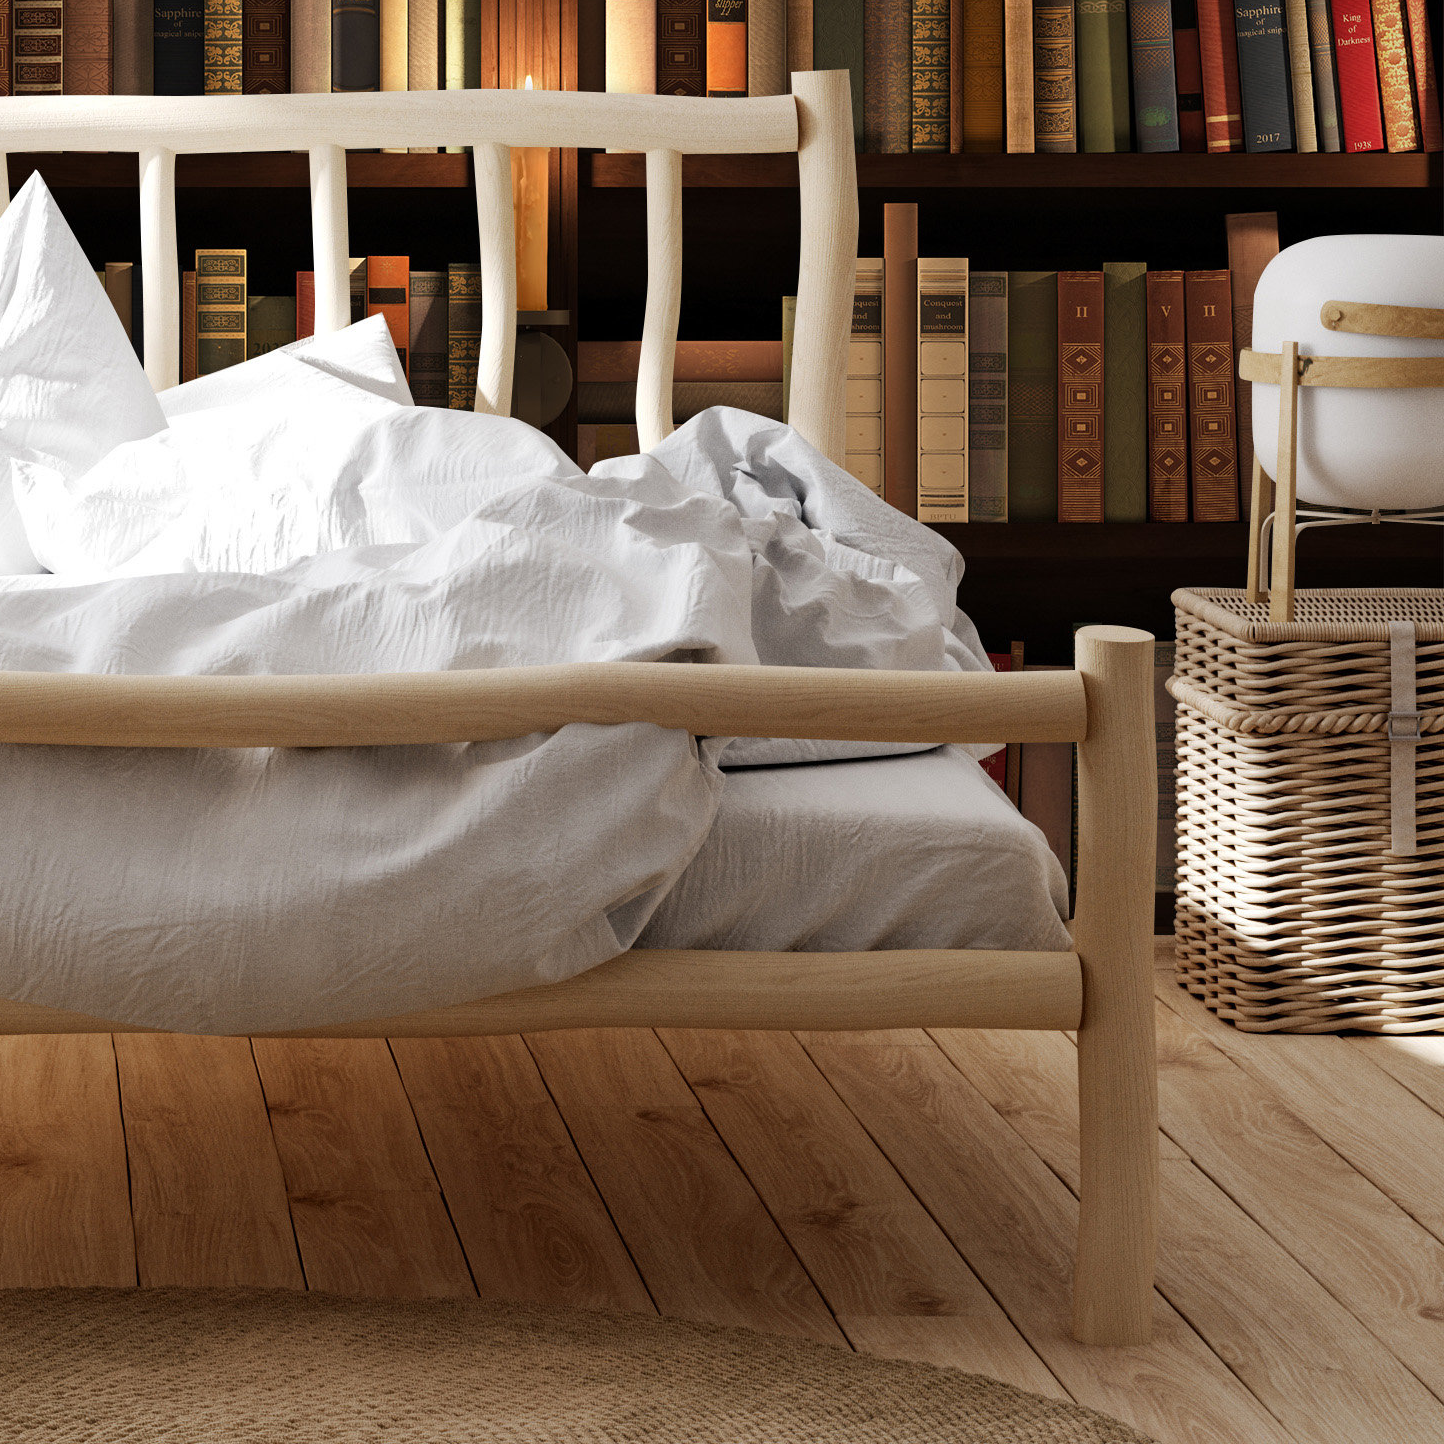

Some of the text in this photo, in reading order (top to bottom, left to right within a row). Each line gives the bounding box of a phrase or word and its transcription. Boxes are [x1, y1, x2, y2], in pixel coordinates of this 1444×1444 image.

[154, 8, 202, 21] Sapphire
[1236, 3, 1283, 20] Sapphire
[1256, 18, 1265, 27] of
[1342, 14, 1362, 24] King
[1237, 27, 1266, 38] magical
[1348, 24, 1357, 34] of
[154, 30, 182, 40] magical
[1338, 36, 1371, 47] Darkness
[1256, 133, 1280, 144] 2017
[1353, 140, 1372, 152] 1938
[924, 299, 963, 309] Conquest
[1076, 306, 1088, 318] II
[1160, 306, 1172, 318] V
[1203, 305, 1216, 317] II
[922, 323, 964, 331] mushroom
